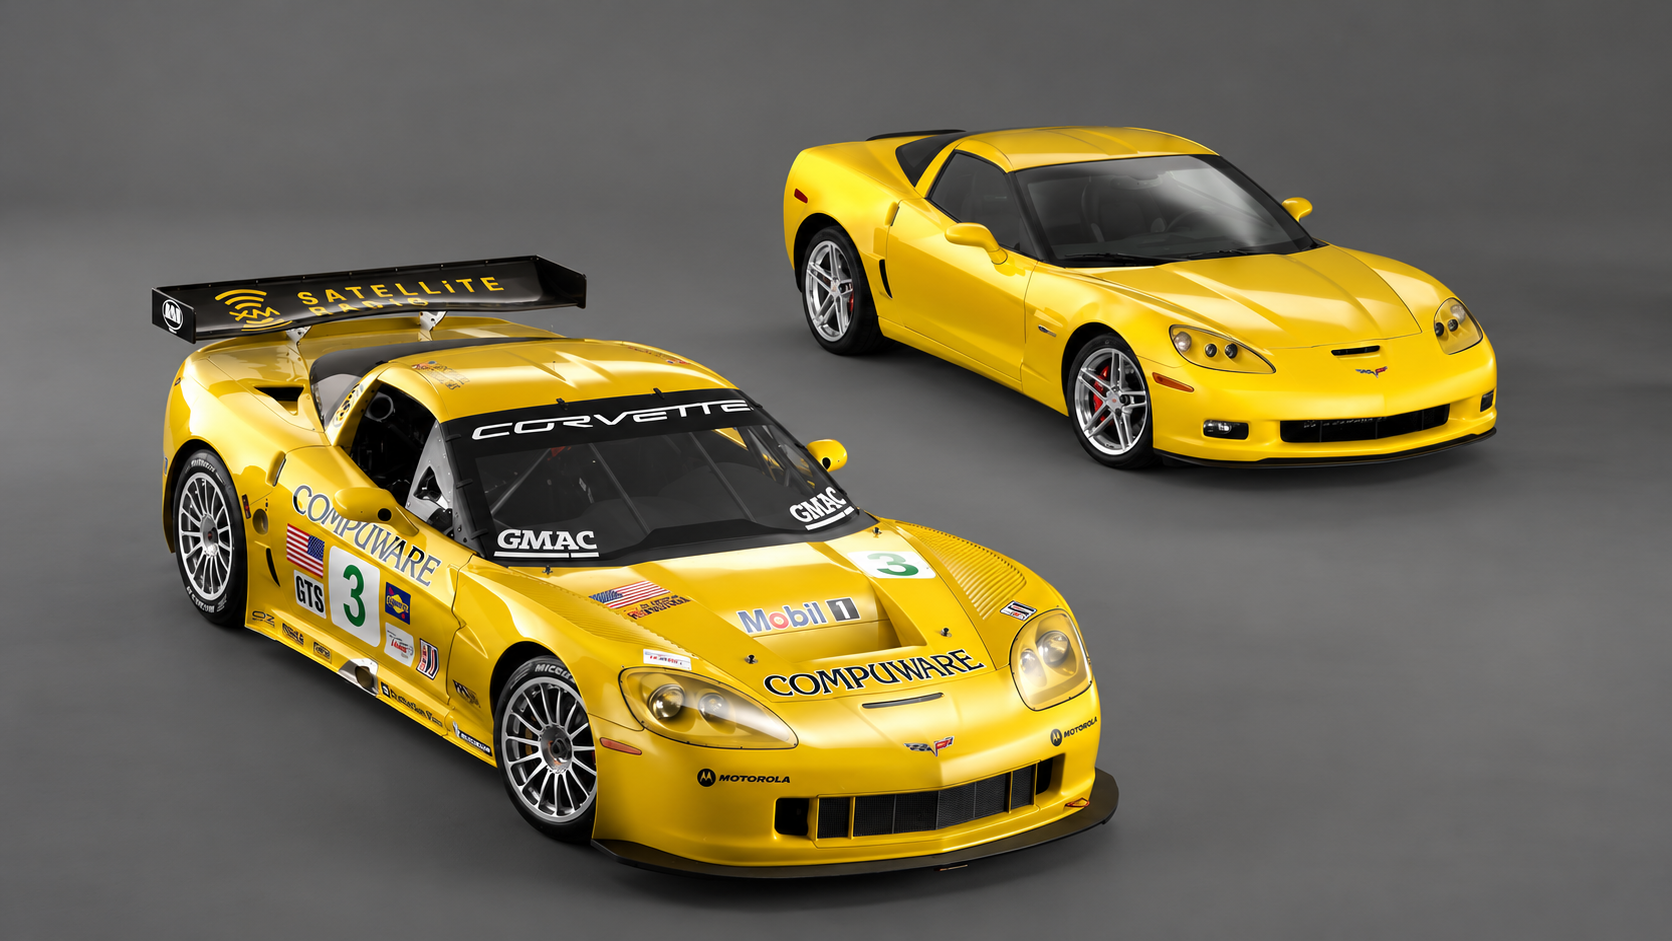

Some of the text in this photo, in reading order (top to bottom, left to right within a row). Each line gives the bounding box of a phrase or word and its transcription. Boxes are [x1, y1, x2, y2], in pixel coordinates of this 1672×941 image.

[472, 400, 752, 440] CORVETTE
[789, 486, 847, 523] GMAC
[497, 528, 598, 550] GMAC
[867, 552, 919, 577] 3
[295, 575, 325, 613] GTS
[342, 564, 366, 628] 3
[738, 602, 828, 634] Mobil
[764, 648, 984, 696] COMPUWARE
[1063, 716, 1098, 738] MOTOROLA
[718, 774, 791, 784] MOTOROLA
